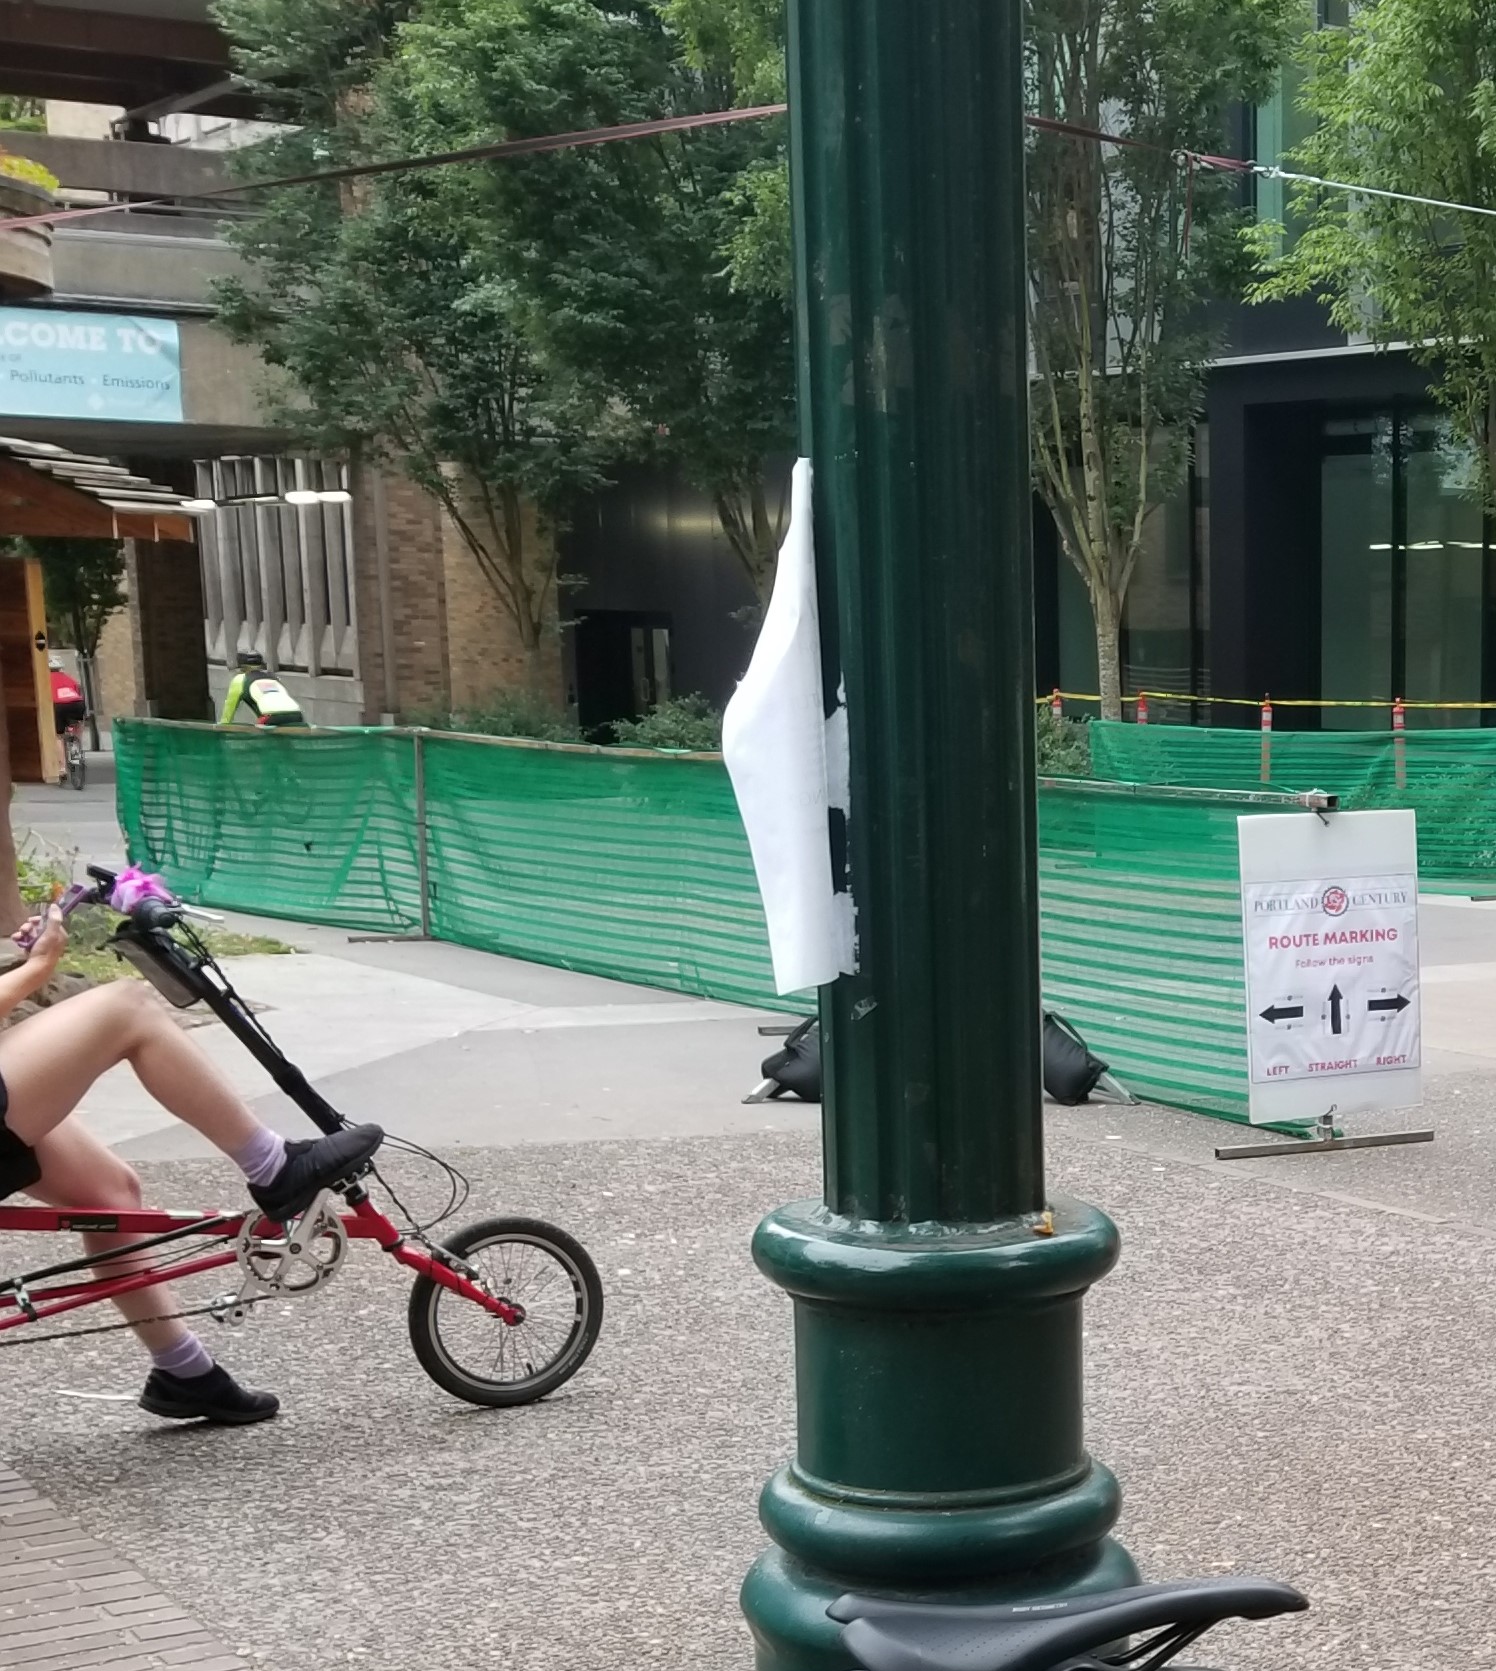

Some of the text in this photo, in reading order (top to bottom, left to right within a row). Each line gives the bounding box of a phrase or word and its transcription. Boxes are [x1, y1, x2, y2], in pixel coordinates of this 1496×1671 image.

[116, 328, 162, 355] TO
[10, 369, 170, 391] Pollutants Emissions
[1254, 891, 1408, 912] PORTLAND CENTURY
[1268, 928, 1398, 949] ROUTE MARKING
[1295, 955, 1374, 968] Follow the signs
[1308, 1060, 1358, 1073] STRAIGHT
[1376, 1055, 1407, 1066] RIGHT
[1266, 1066, 1290, 1076] LEFT
